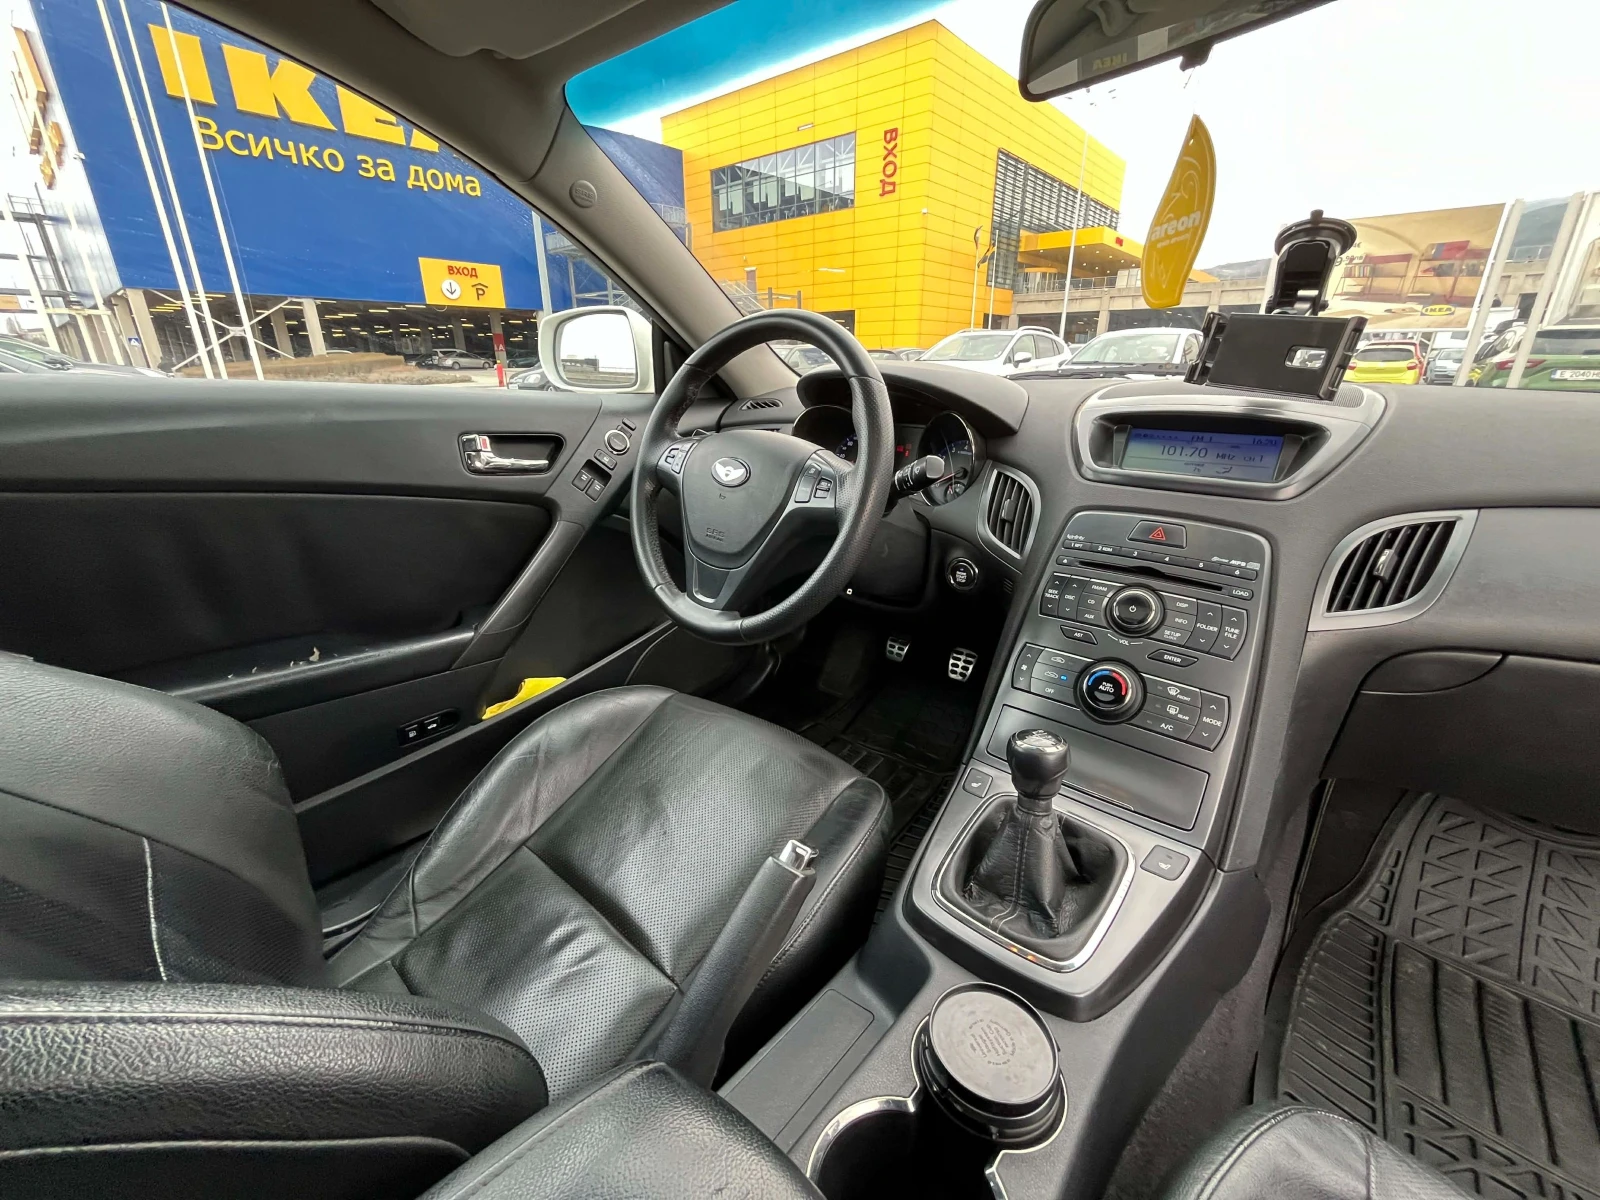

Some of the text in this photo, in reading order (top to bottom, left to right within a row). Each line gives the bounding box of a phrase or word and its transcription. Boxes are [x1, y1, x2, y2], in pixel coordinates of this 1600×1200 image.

[194, 115, 482, 197] Всичко за дома
[879, 127, 899, 197] ВХОД
[1151, 210, 1201, 241] areon
[447, 265, 479, 279] ВХОД
[1161, 444, 1208, 458] 101.70
[1233, 589, 1249, 597] LOAD
[1174, 617, 1188, 625] INFO
[1197, 622, 1219, 632] FOLDER
[1225, 626, 1240, 635] TUNE
[1164, 629, 1182, 637] SETUP
[1224, 632, 1238, 640] FILE
[1118, 638, 1130, 646] VOL
[1163, 654, 1182, 663] ENTER
[1098, 685, 1115, 694] AUTO
[1202, 716, 1223, 727] MODE
[1160, 722, 1174, 731] A/C
